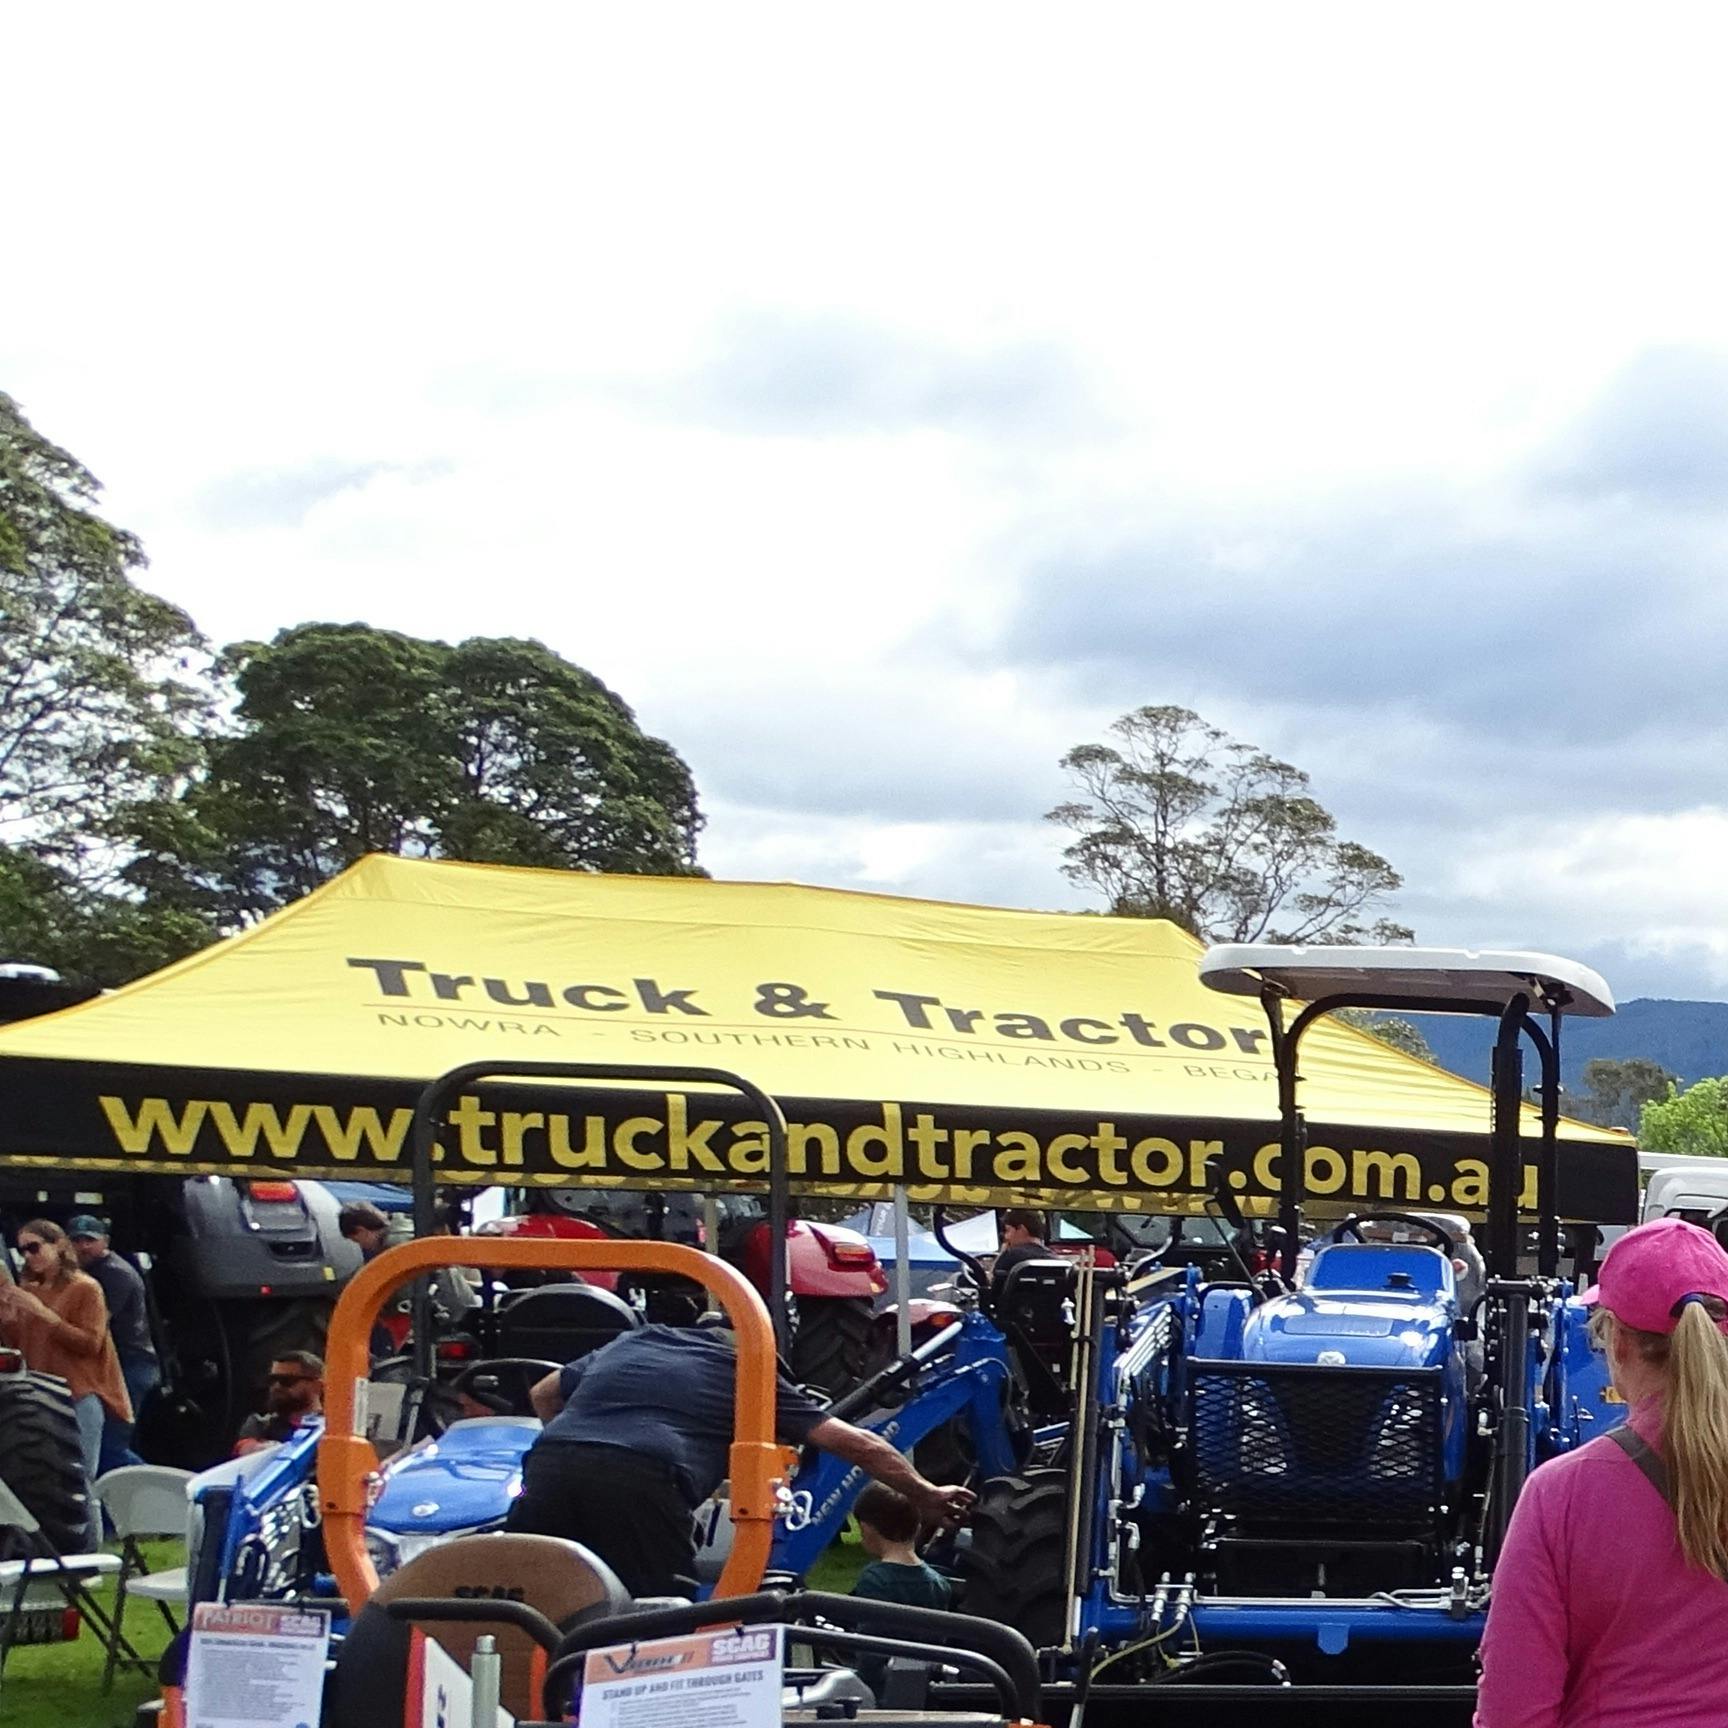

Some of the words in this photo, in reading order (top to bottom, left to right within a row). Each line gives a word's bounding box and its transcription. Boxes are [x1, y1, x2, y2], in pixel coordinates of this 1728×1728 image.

[346, 957, 712, 1018] Truck
[754, 982, 840, 1021] &
[873, 989, 1272, 1056] Tractor
[378, 1012, 562, 1037] NOWRA
[630, 1028, 871, 1053] SOUTHERN
[893, 1041, 1143, 1073] HIGHLANDS
[711, 1634, 771, 1658] SCAG
[602, 1688, 633, 1700] STAND
[635, 1685, 648, 1696] UP
[649, 1683, 668, 1694] AND
[687, 1676, 733, 1689] THROUGH
[734, 1670, 764, 1683] GATES
